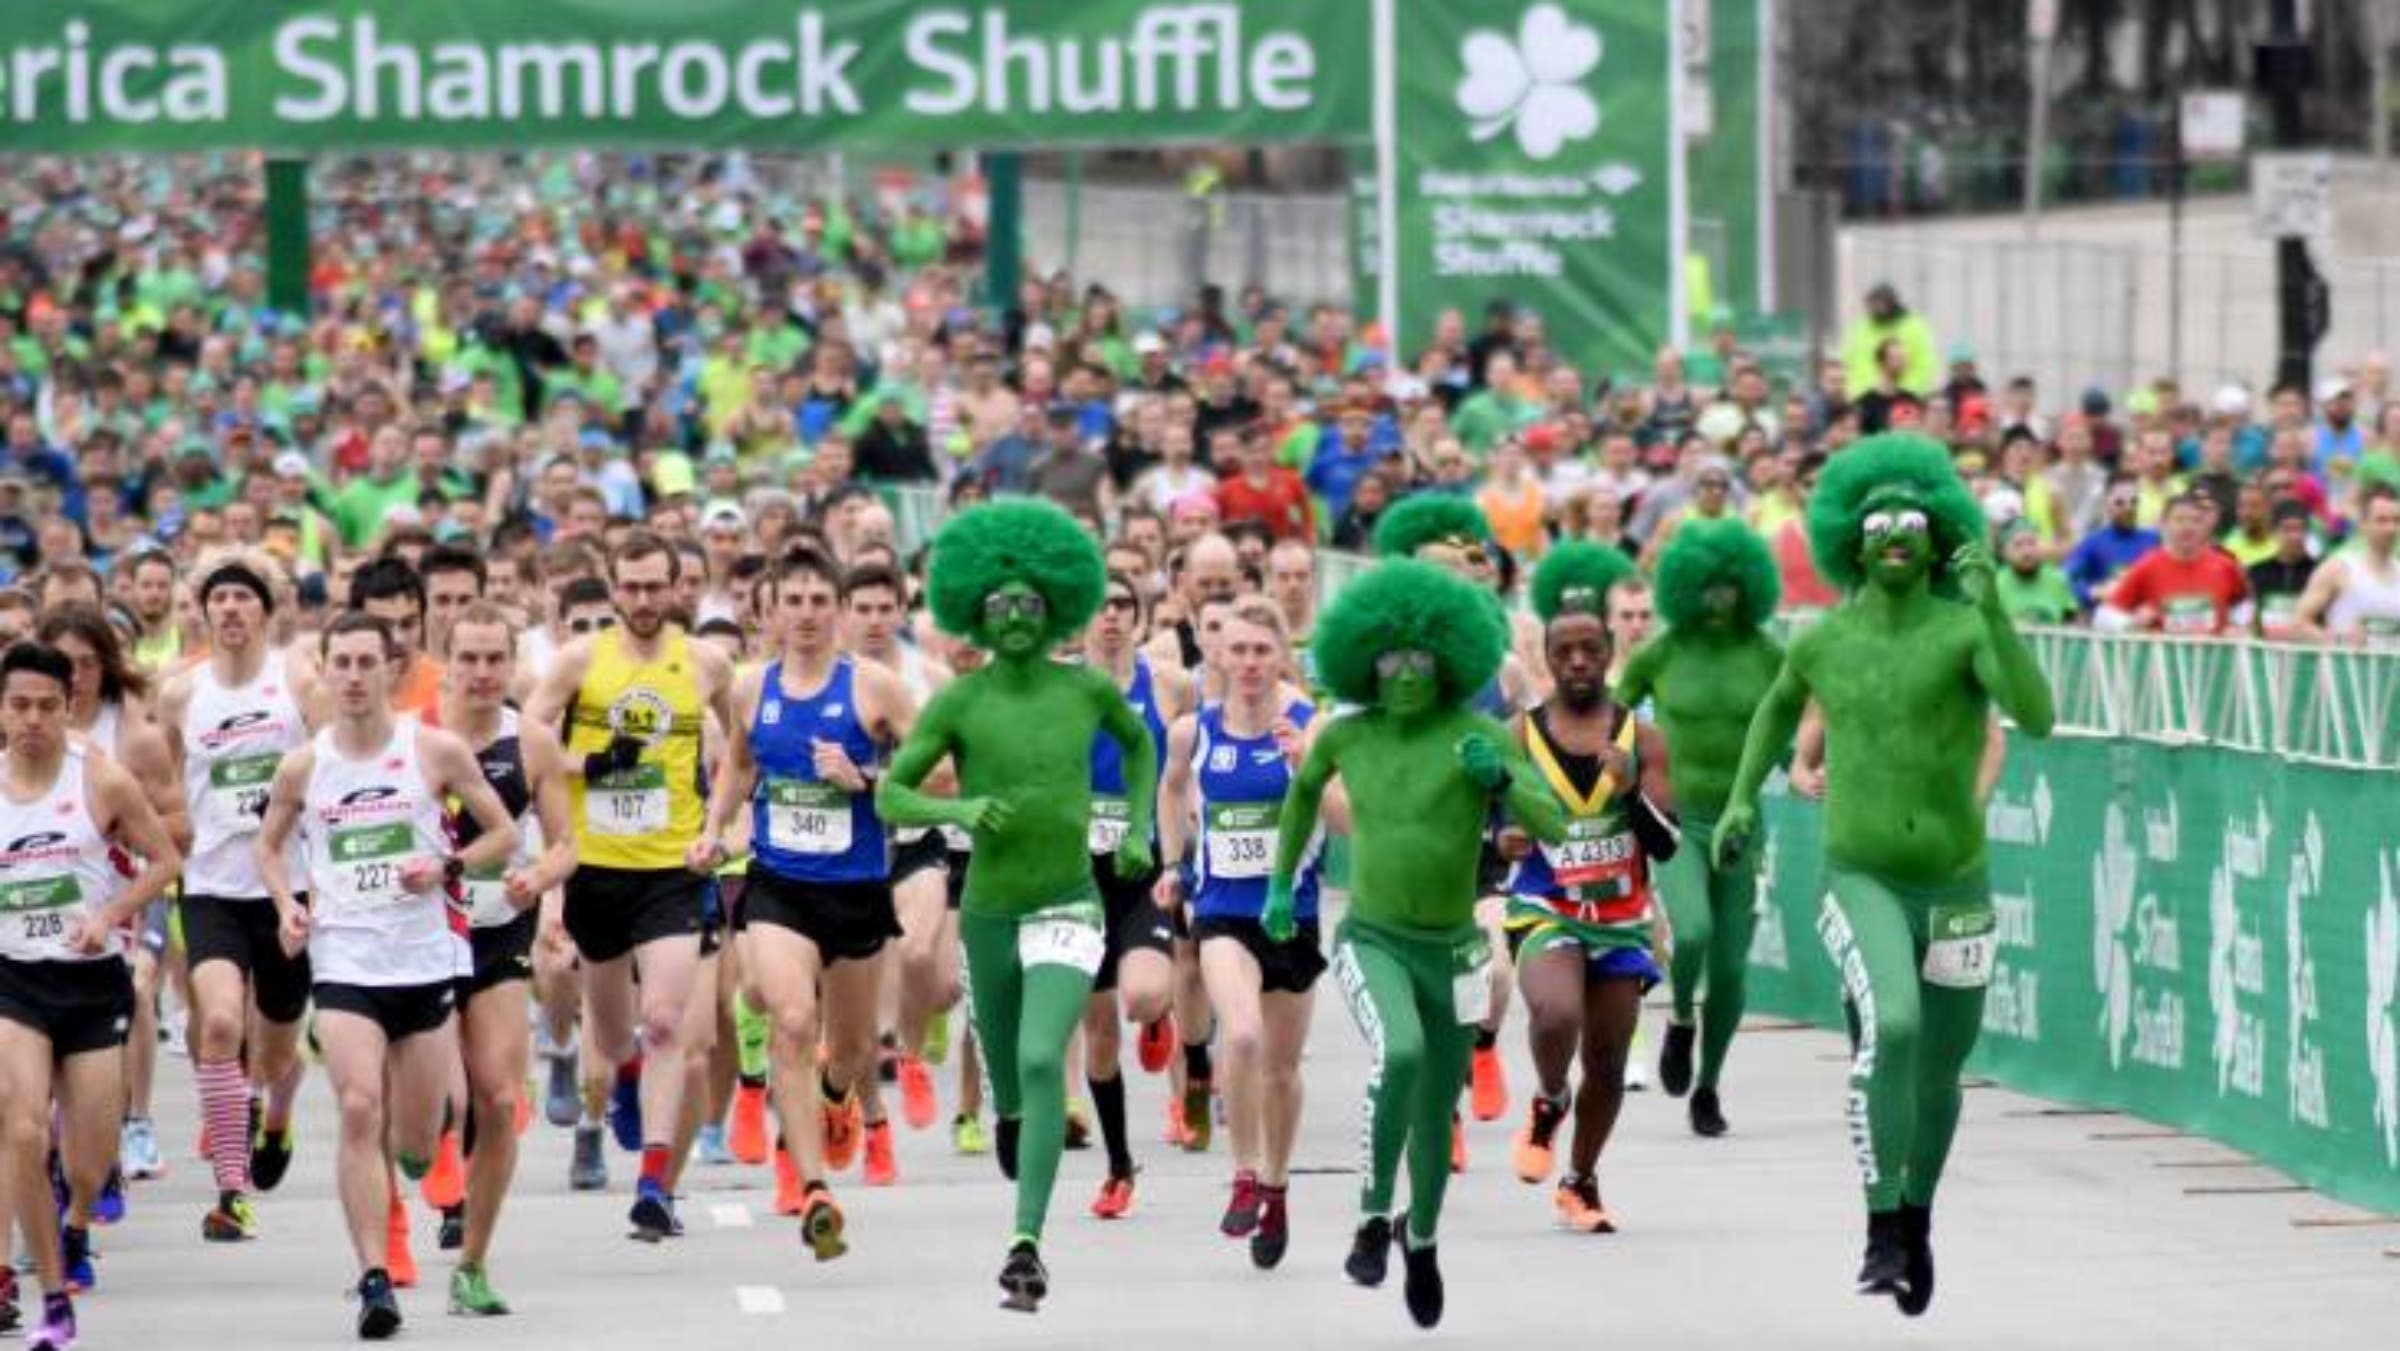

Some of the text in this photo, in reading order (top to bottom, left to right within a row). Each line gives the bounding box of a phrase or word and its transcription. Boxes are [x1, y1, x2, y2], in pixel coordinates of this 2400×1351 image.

[0, 2, 1316, 123] rica Shamrock Shuffle
[611, 794, 646, 819] 107
[791, 811, 827, 836] 340
[1228, 837, 1267, 862] 338
[355, 863, 391, 891] 227
[23, 913, 63, 938] 228
